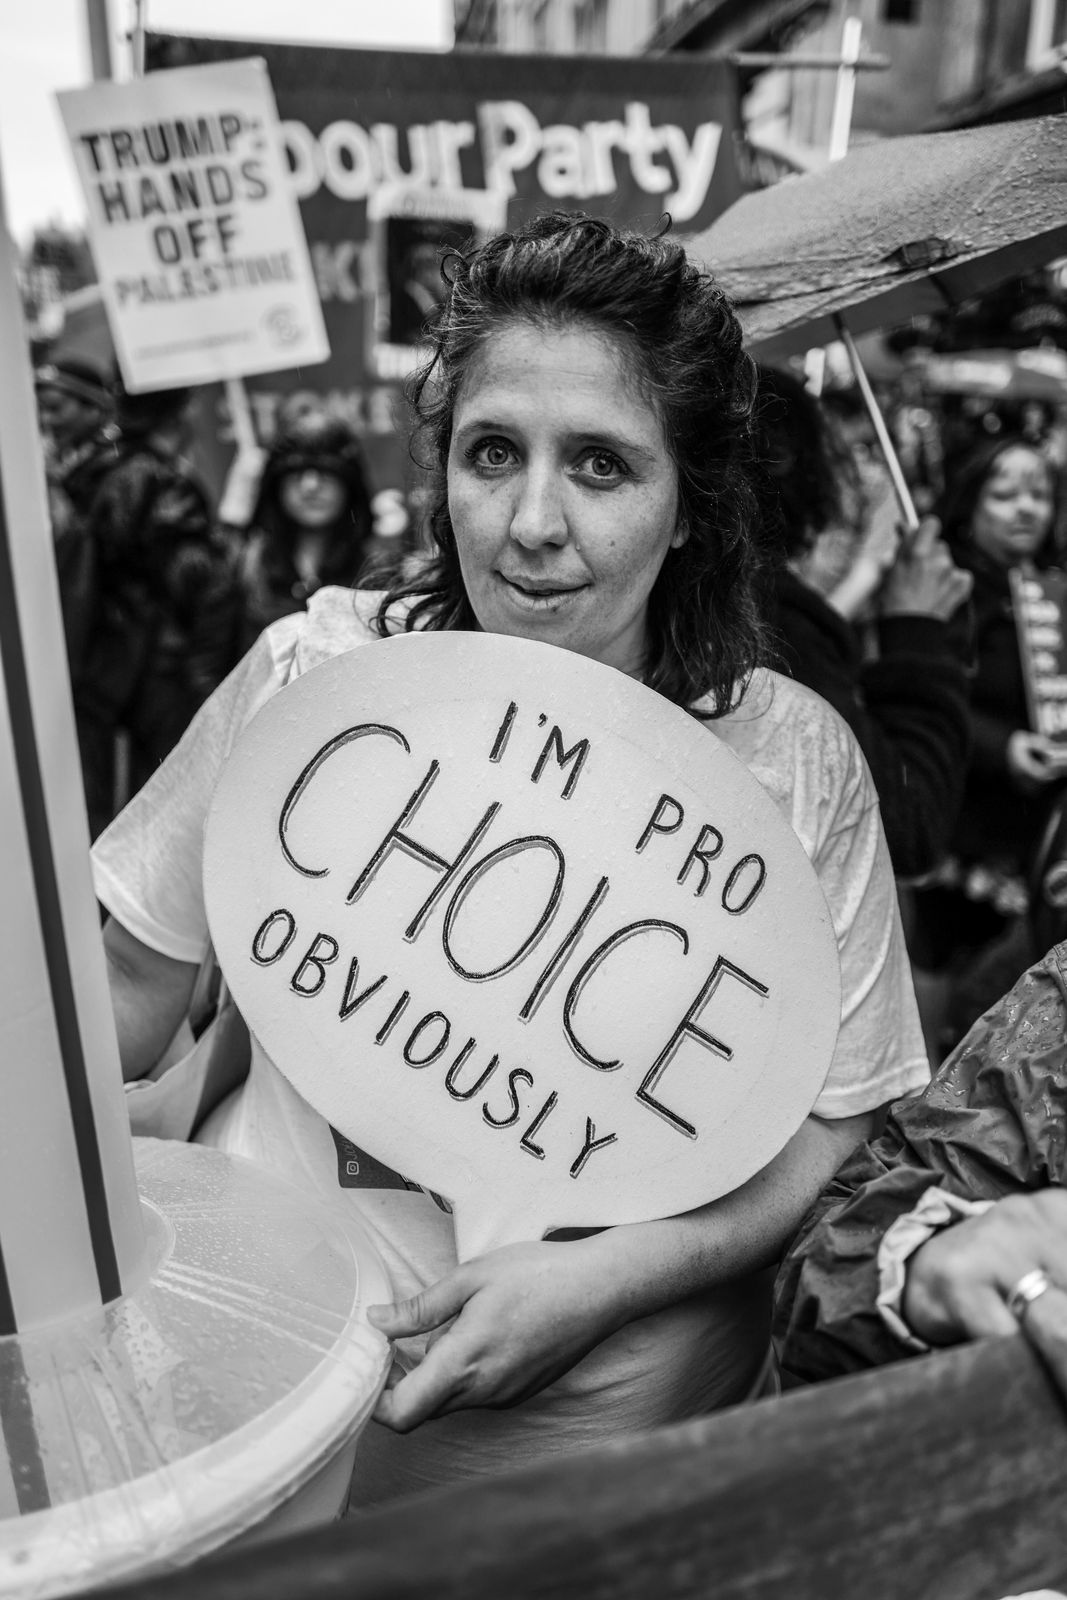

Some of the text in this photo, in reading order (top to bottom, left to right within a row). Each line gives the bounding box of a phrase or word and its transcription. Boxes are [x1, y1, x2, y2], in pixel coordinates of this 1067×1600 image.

[98, 157, 269, 224] HANDS
[152, 213, 236, 265] OFF
[475, 99, 723, 222] Party
[489, 701, 767, 915] I'M PRO
[278, 722, 771, 1140] CHOICE
[249, 907, 618, 1178] OBVIOUSLY
